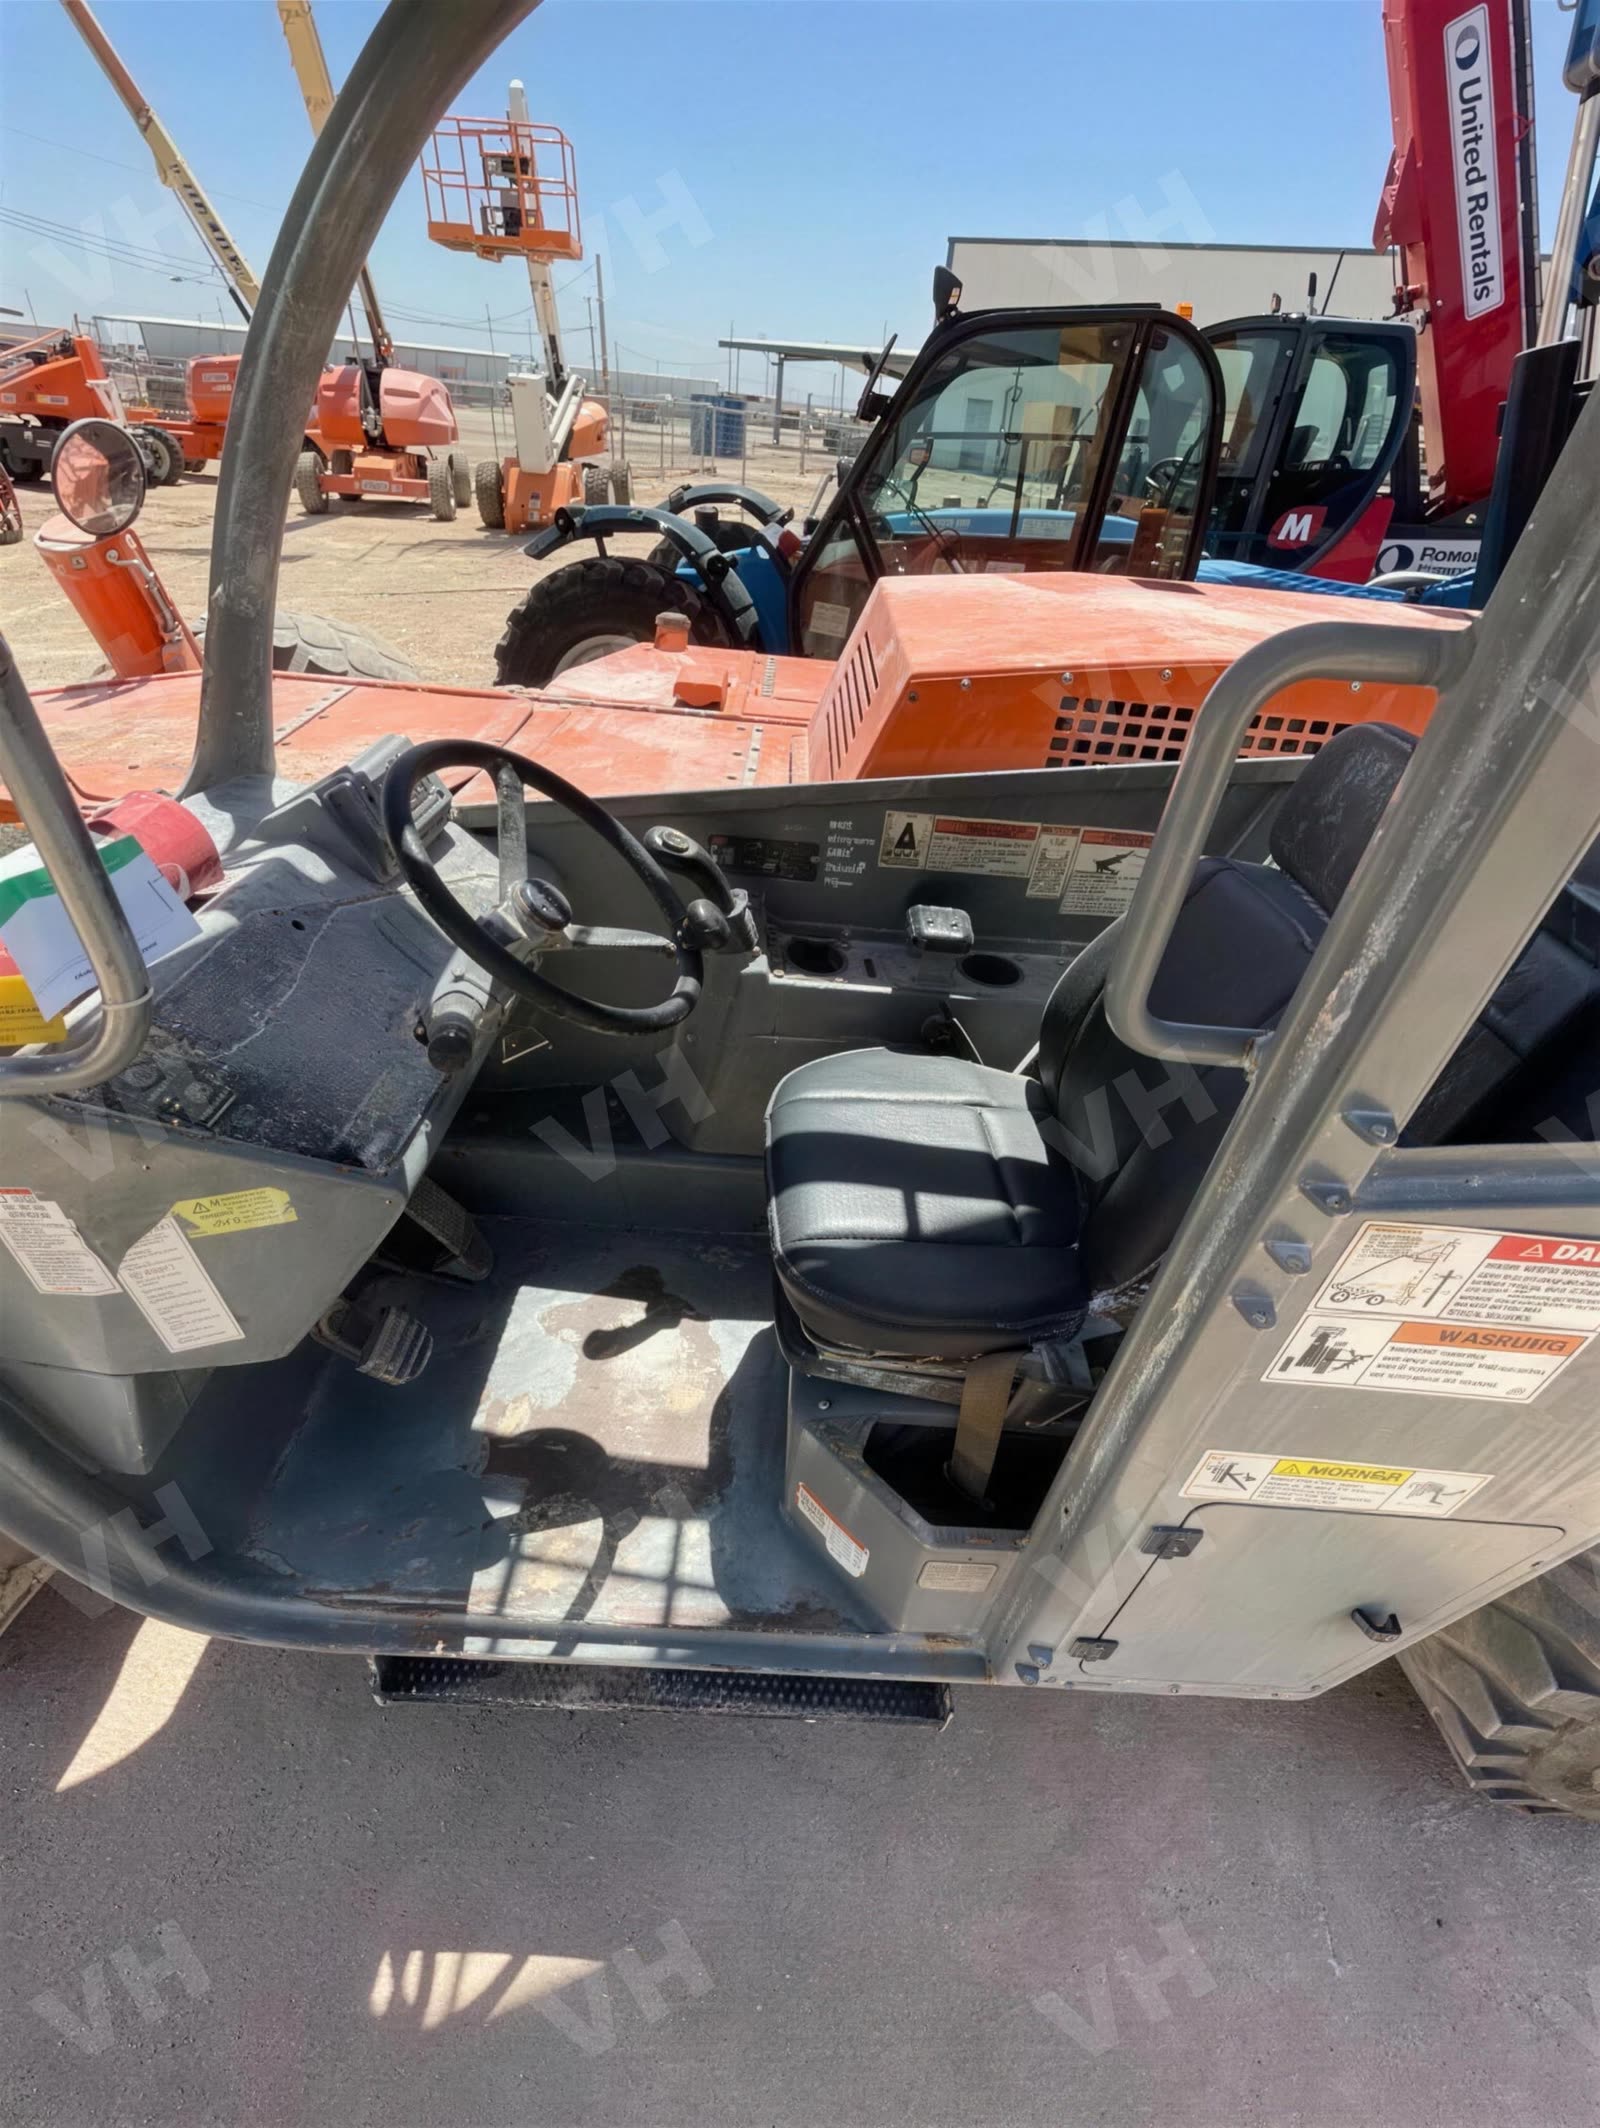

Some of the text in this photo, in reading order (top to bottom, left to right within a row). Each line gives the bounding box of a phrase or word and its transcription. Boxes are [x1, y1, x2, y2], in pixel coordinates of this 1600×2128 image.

[1458, 76, 1494, 301] United Rentals
[1277, 513, 1313, 542] M
[1552, 1244, 1600, 1263] DA
